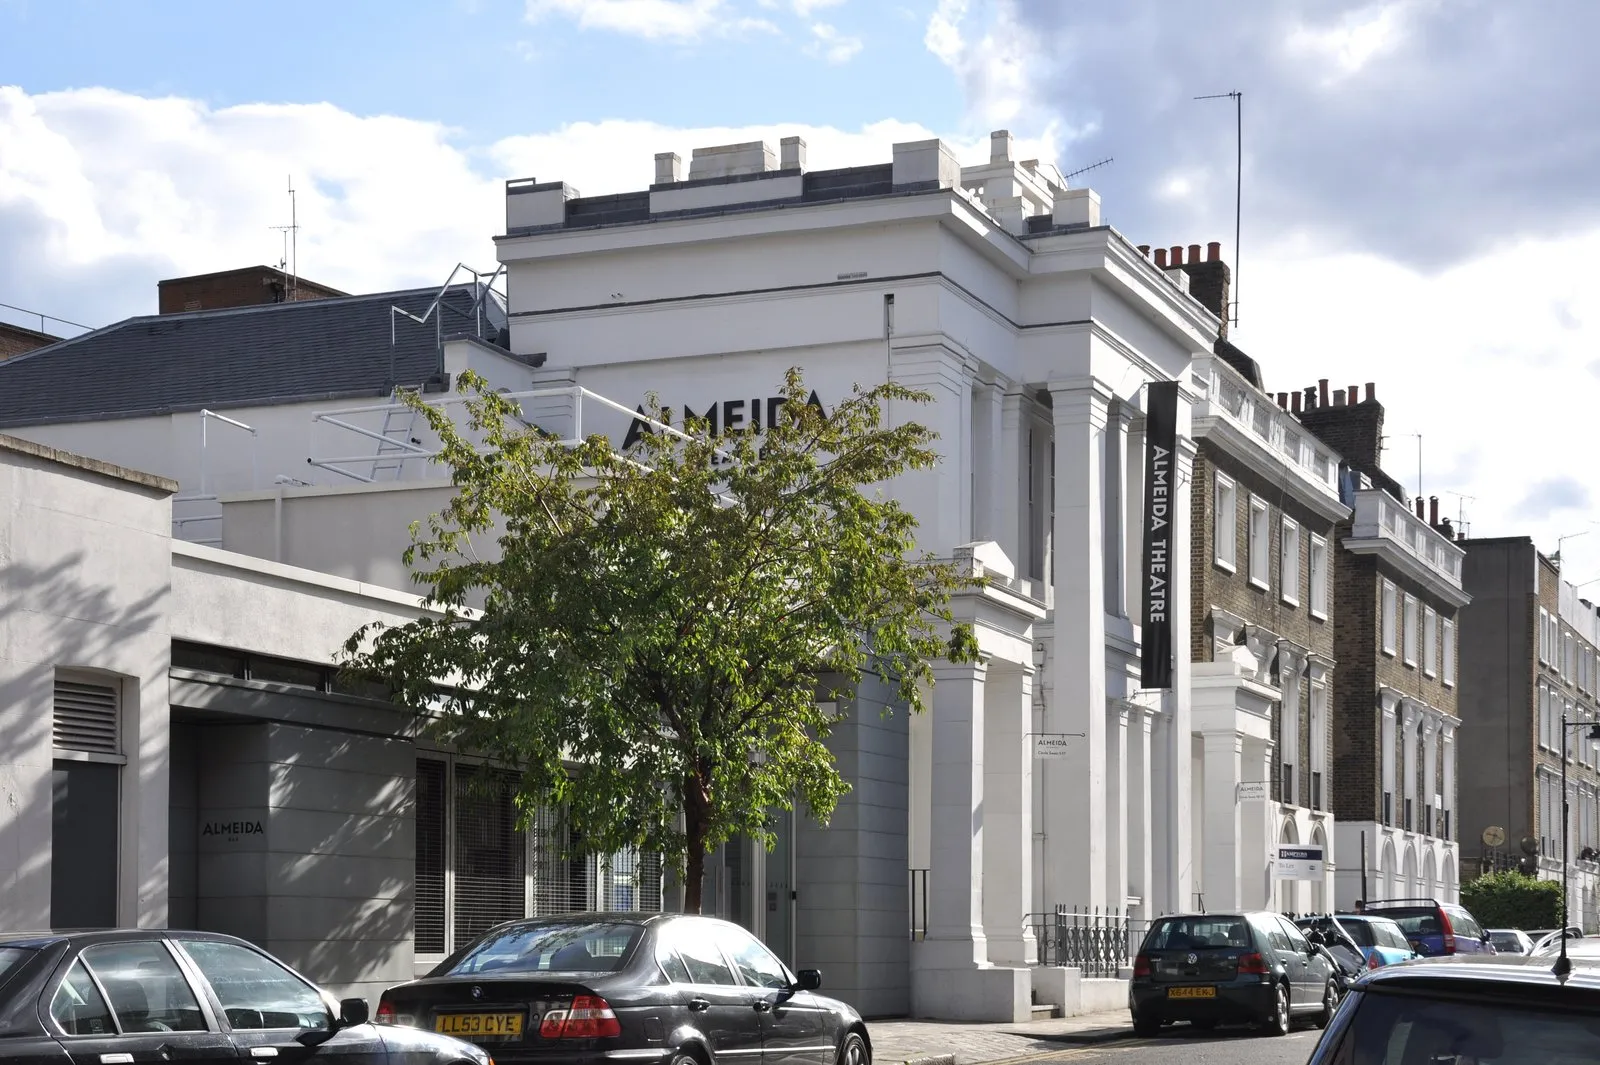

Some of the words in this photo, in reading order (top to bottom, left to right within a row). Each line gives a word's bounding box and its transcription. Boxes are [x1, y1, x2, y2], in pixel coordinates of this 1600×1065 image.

[621, 389, 829, 450] ALMEIDA
[1151, 445, 1169, 531] ALMEIDA
[1150, 539, 1166, 622] THEATRE
[203, 820, 263, 835] ALMEIDA
[441, 1016, 480, 1033] LL53
[485, 1015, 516, 1032] CYE
